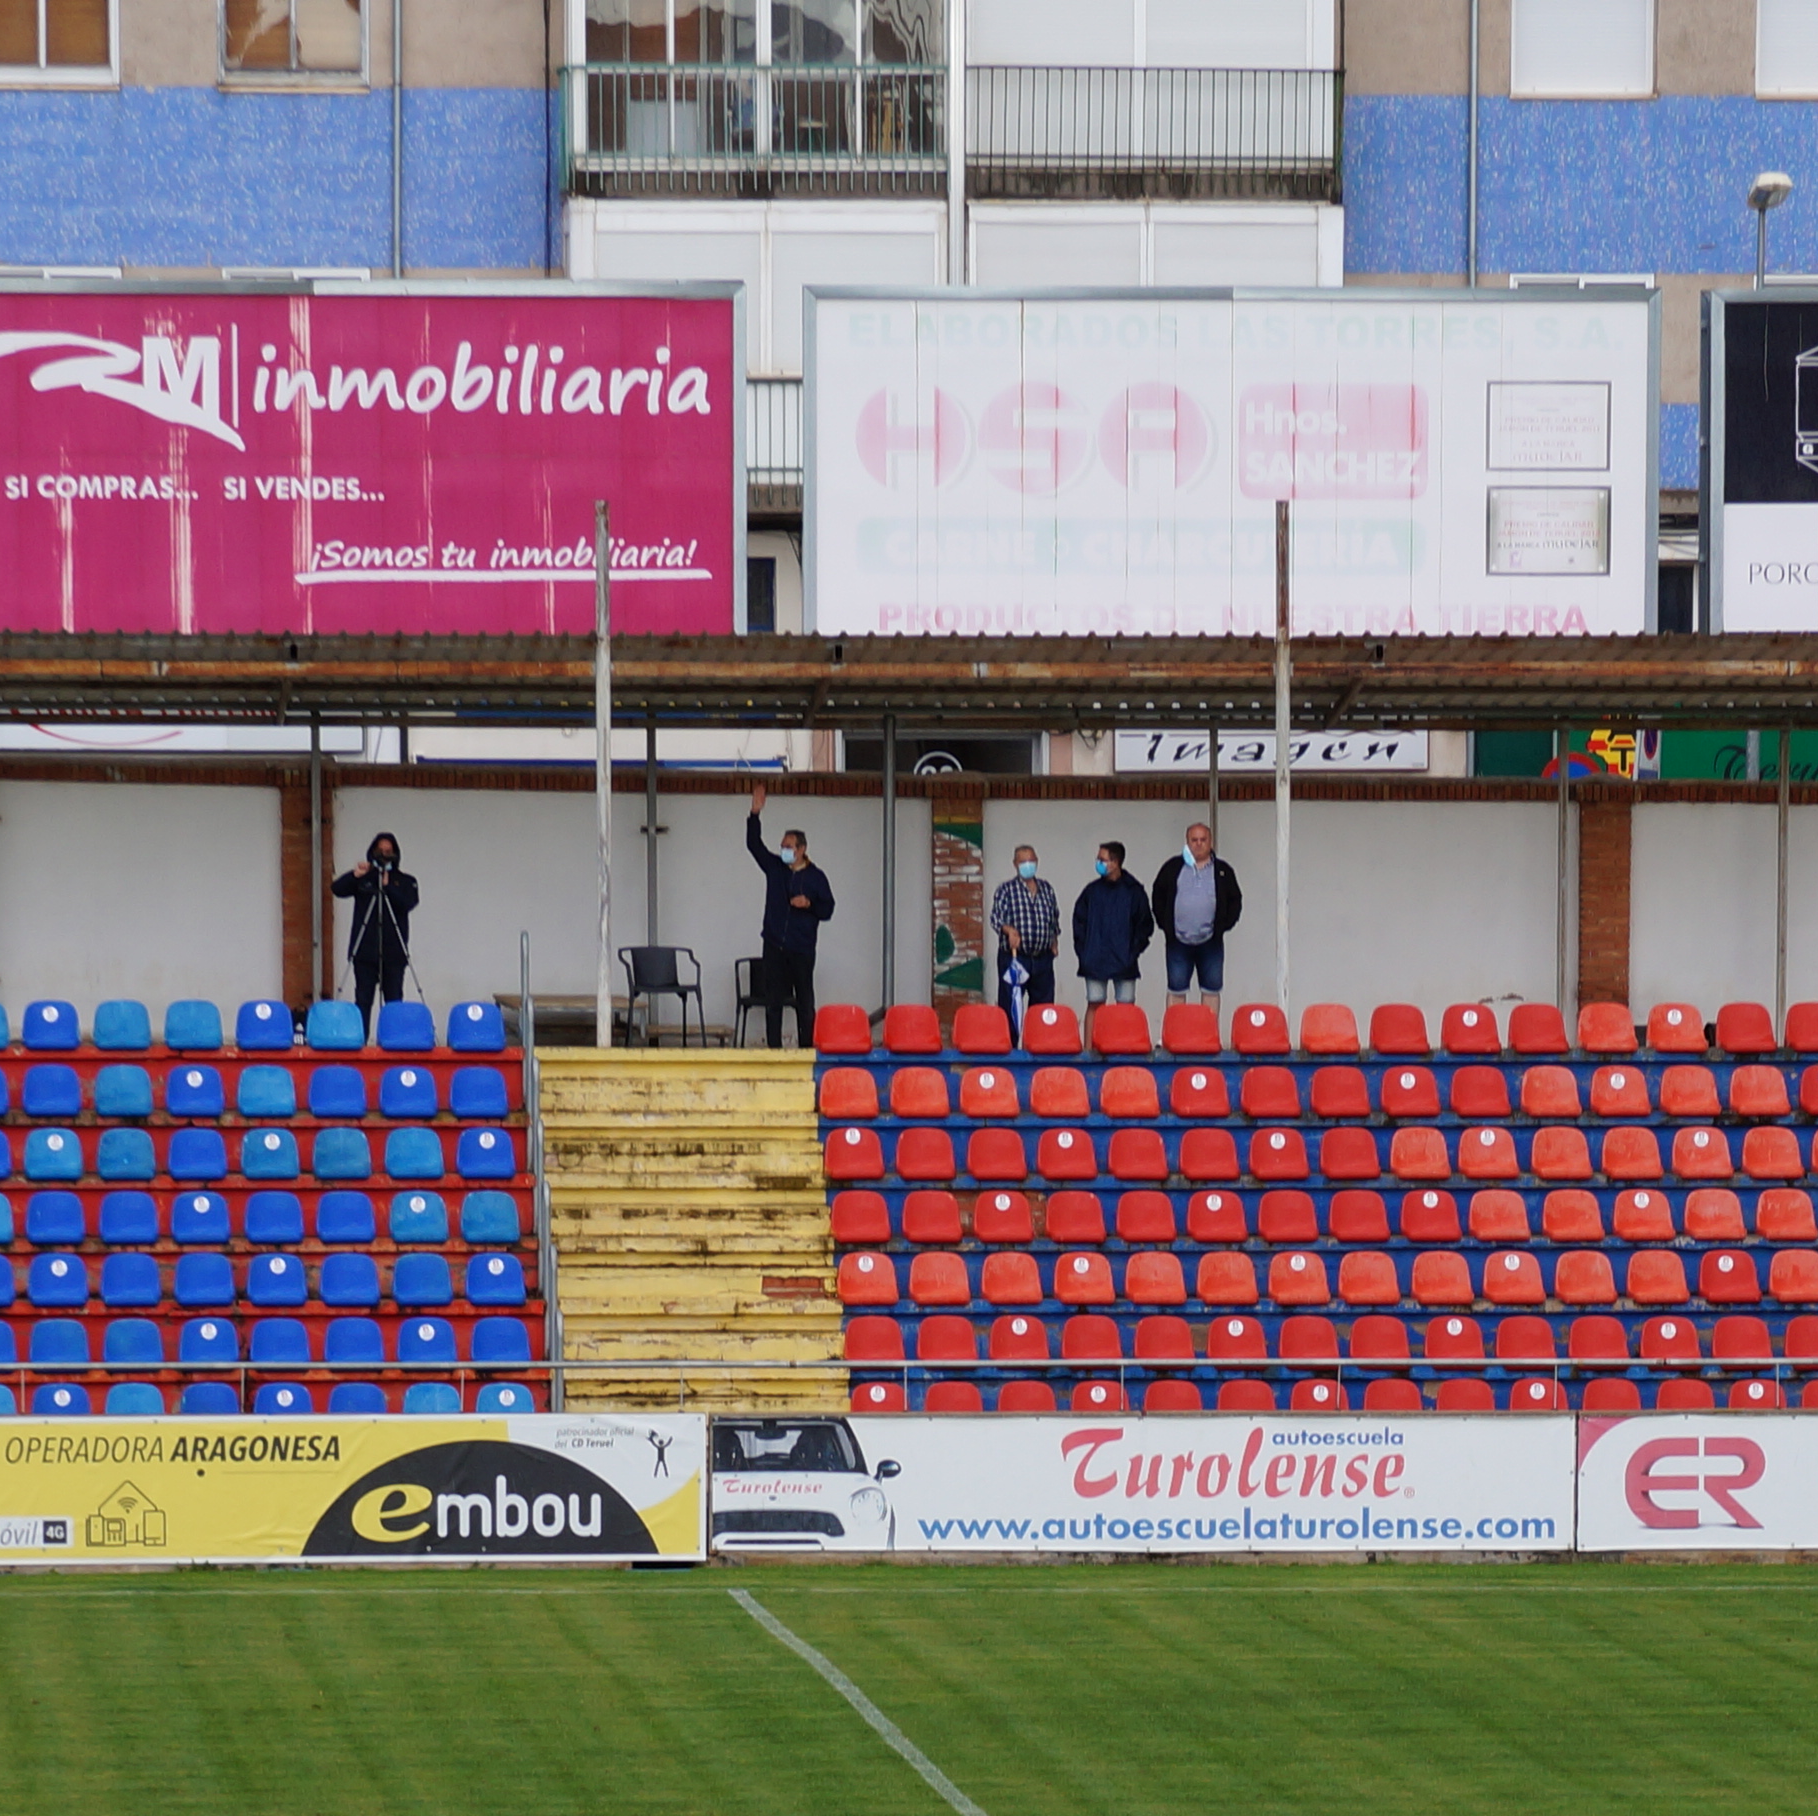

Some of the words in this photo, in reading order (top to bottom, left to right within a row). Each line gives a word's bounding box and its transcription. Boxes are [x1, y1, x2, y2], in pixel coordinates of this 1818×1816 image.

[847, 313, 1178, 350] ELABORADOS
[253, 340, 712, 416] inmobiliaria
[1244, 401, 1348, 438] Hnos.
[1244, 450, 1422, 487] SANCHEZ
[4, 476, 28, 499] SI
[37, 476, 199, 500] COMPRAS...
[223, 477, 246, 500] SI
[254, 477, 385, 501] VENDES...
[311, 539, 429, 572] ¡Somos
[441, 541, 476, 568] tu
[878, 603, 1135, 634] PRODUCTOS
[1433, 605, 1589, 635] TIERRA
[5, 1437, 164, 1464] OPERADORA
[171, 1435, 341, 1462] ARAGONESA
[556, 1427, 608, 1438] patrocinador
[609, 1427, 634, 1437] oficial
[1272, 1426, 1404, 1447] autoescuela
[1061, 1427, 1405, 1499] Turolense
[723, 1479, 822, 1494] Turolense
[1624, 1436, 1766, 1529] ER
[351, 1472, 603, 1543] embou
[919, 1507, 1555, 1541] www.autoescuelaturolense.com
